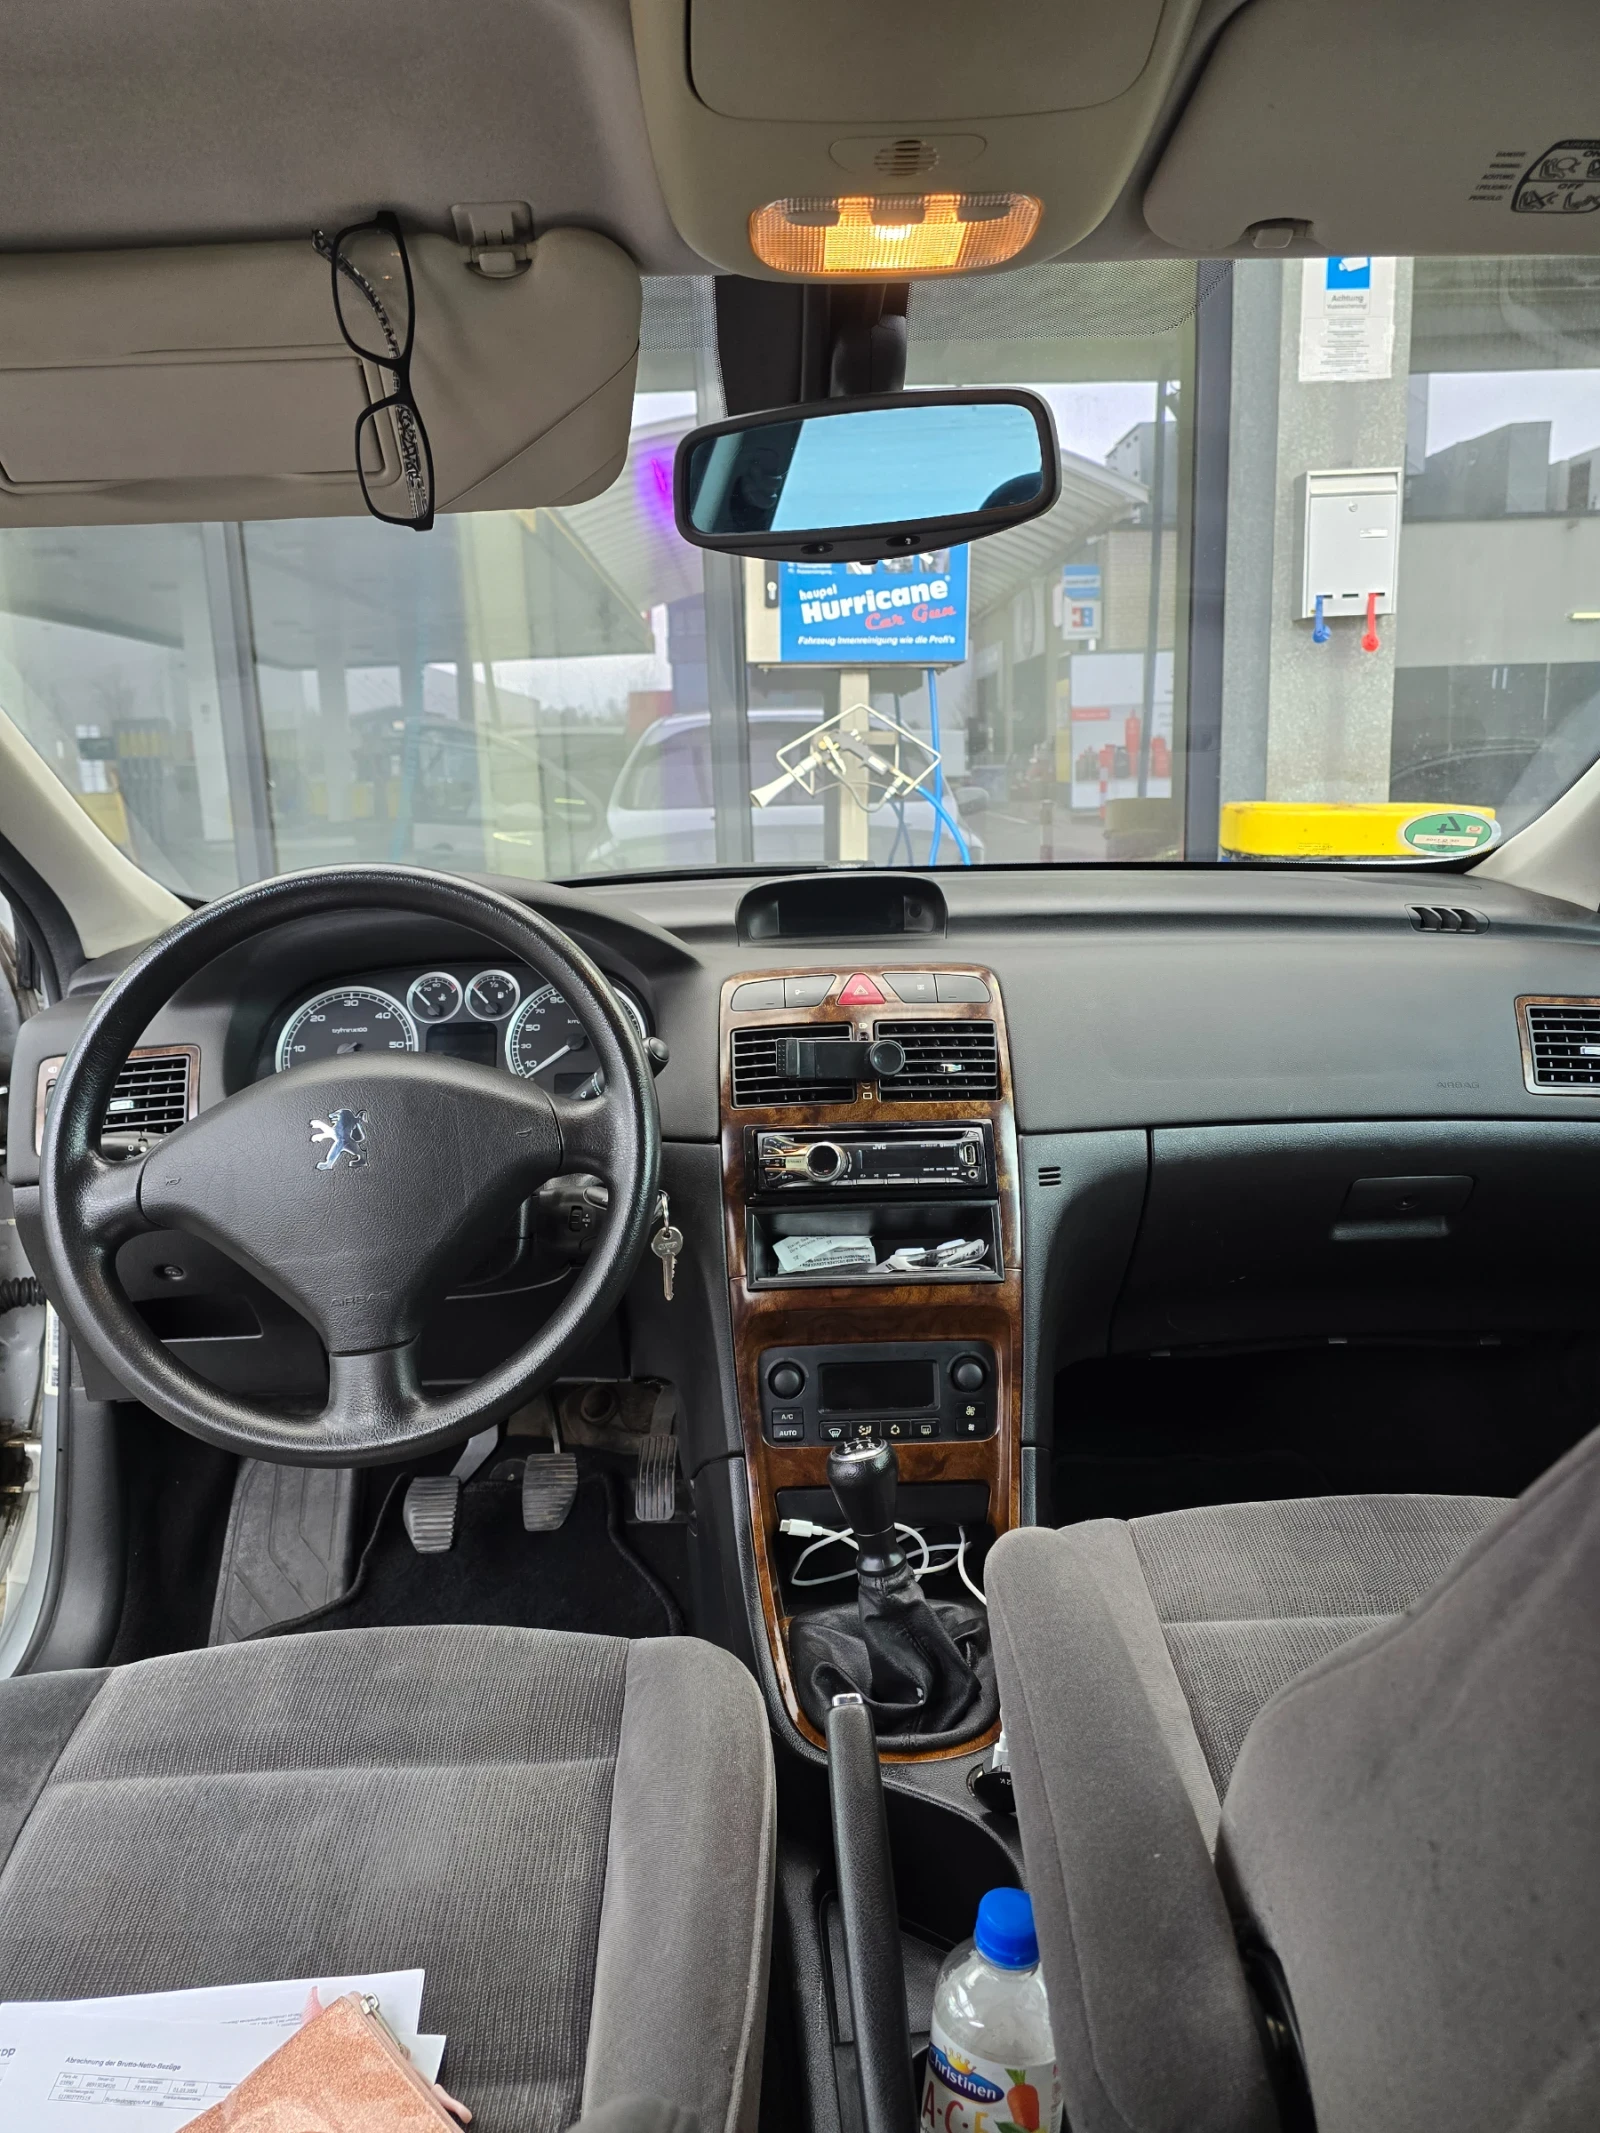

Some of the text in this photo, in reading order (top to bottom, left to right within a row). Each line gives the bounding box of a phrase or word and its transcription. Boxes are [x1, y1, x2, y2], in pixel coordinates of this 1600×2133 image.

[1332, 295, 1364, 303] Achtung
[801, 580, 948, 624] Hurricane
[865, 604, 956, 630] Car Gun
[798, 635, 955, 646] Fahrzeug Innenreinigung wie die Profi's
[65, 2057, 182, 2071] Abrechnung der Brutto-Netto-Bezüge
[929, 2046, 997, 2100] Christinen
